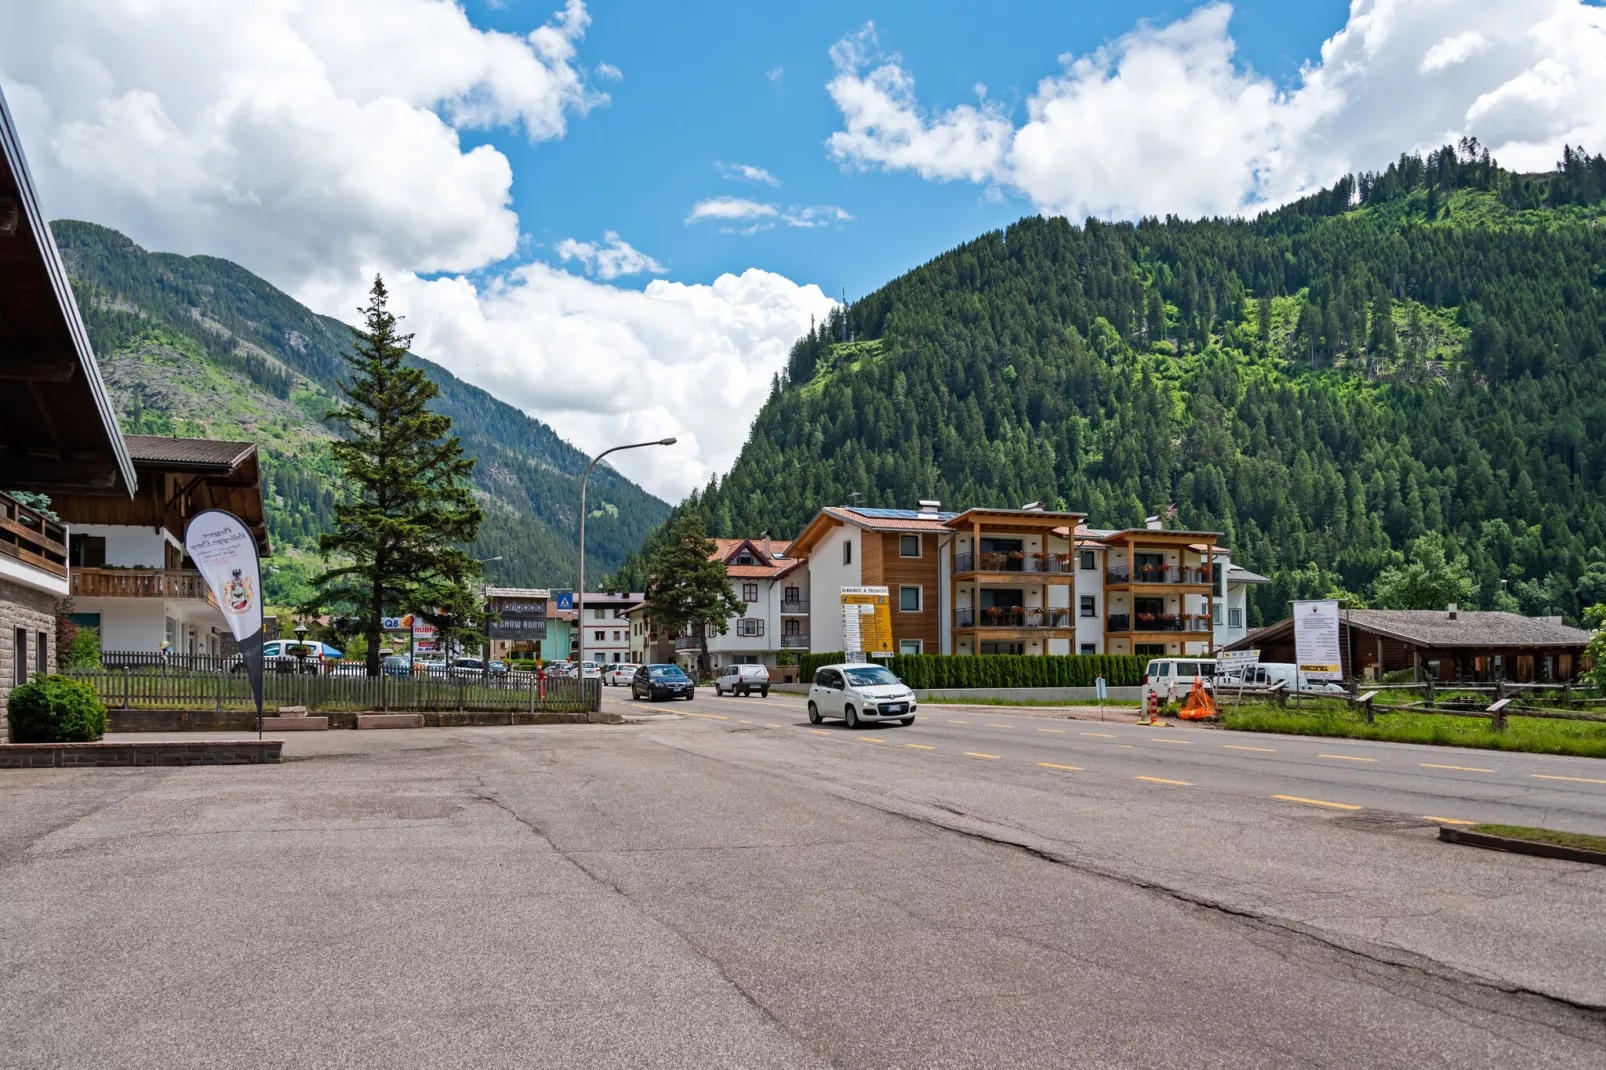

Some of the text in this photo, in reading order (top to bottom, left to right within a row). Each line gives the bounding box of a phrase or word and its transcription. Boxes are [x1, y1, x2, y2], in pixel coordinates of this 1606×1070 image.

[384, 619, 399, 628] Q8
[499, 620, 545, 629] SHOW ROOM
